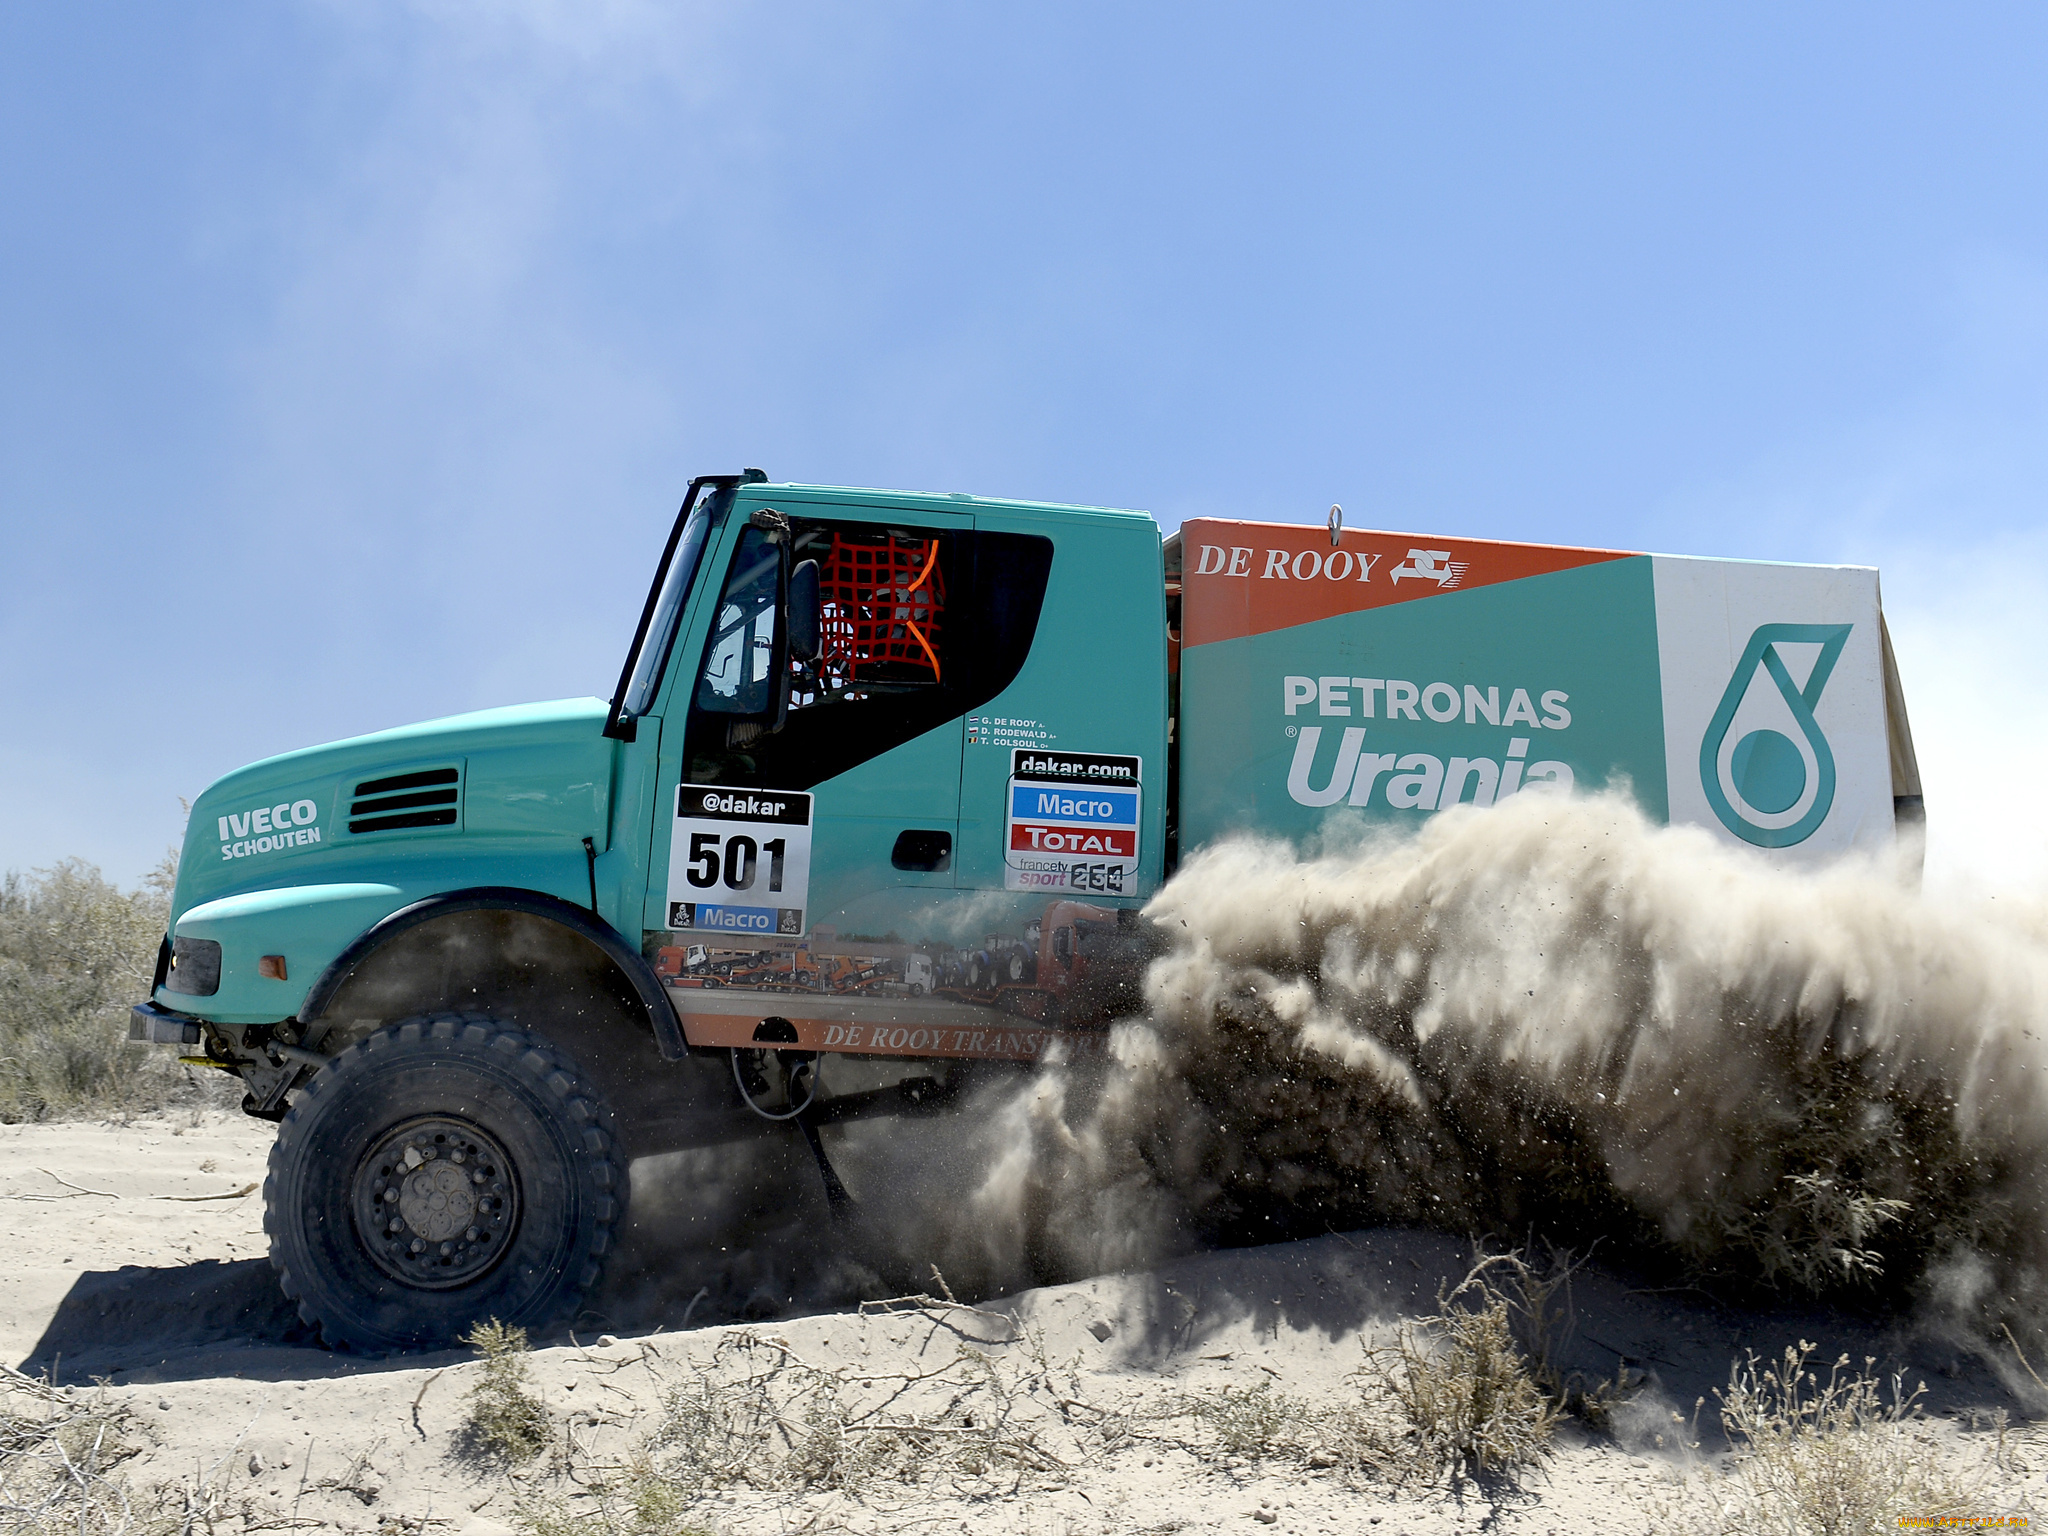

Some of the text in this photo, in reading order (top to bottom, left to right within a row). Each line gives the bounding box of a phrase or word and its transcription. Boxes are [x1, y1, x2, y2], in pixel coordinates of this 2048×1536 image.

[1194, 544, 1382, 583] DE ROOY
[1284, 675, 1572, 730] PETRONAS
[981, 716, 992, 725] G.
[994, 717, 1008, 726] DE
[1009, 718, 1037, 728] ROOY
[981, 727, 991, 735] D.
[993, 728, 1047, 739] RODEWALD
[980, 737, 989, 745] T.
[993, 738, 1039, 748] COLSOUL
[1021, 756, 1131, 780] dakar.com
[702, 793, 786, 816] @dakar
[1037, 793, 1113, 818] Macro
[218, 799, 318, 841] IVECO
[221, 826, 321, 861] SCHOUTEN
[1025, 827, 1122, 854] TOTAL
[686, 832, 786, 893] 501
[1019, 872, 1067, 887] sport
[704, 908, 769, 929] Macro
[823, 1025, 863, 1047] DE
[869, 1027, 948, 1051] ROOY
